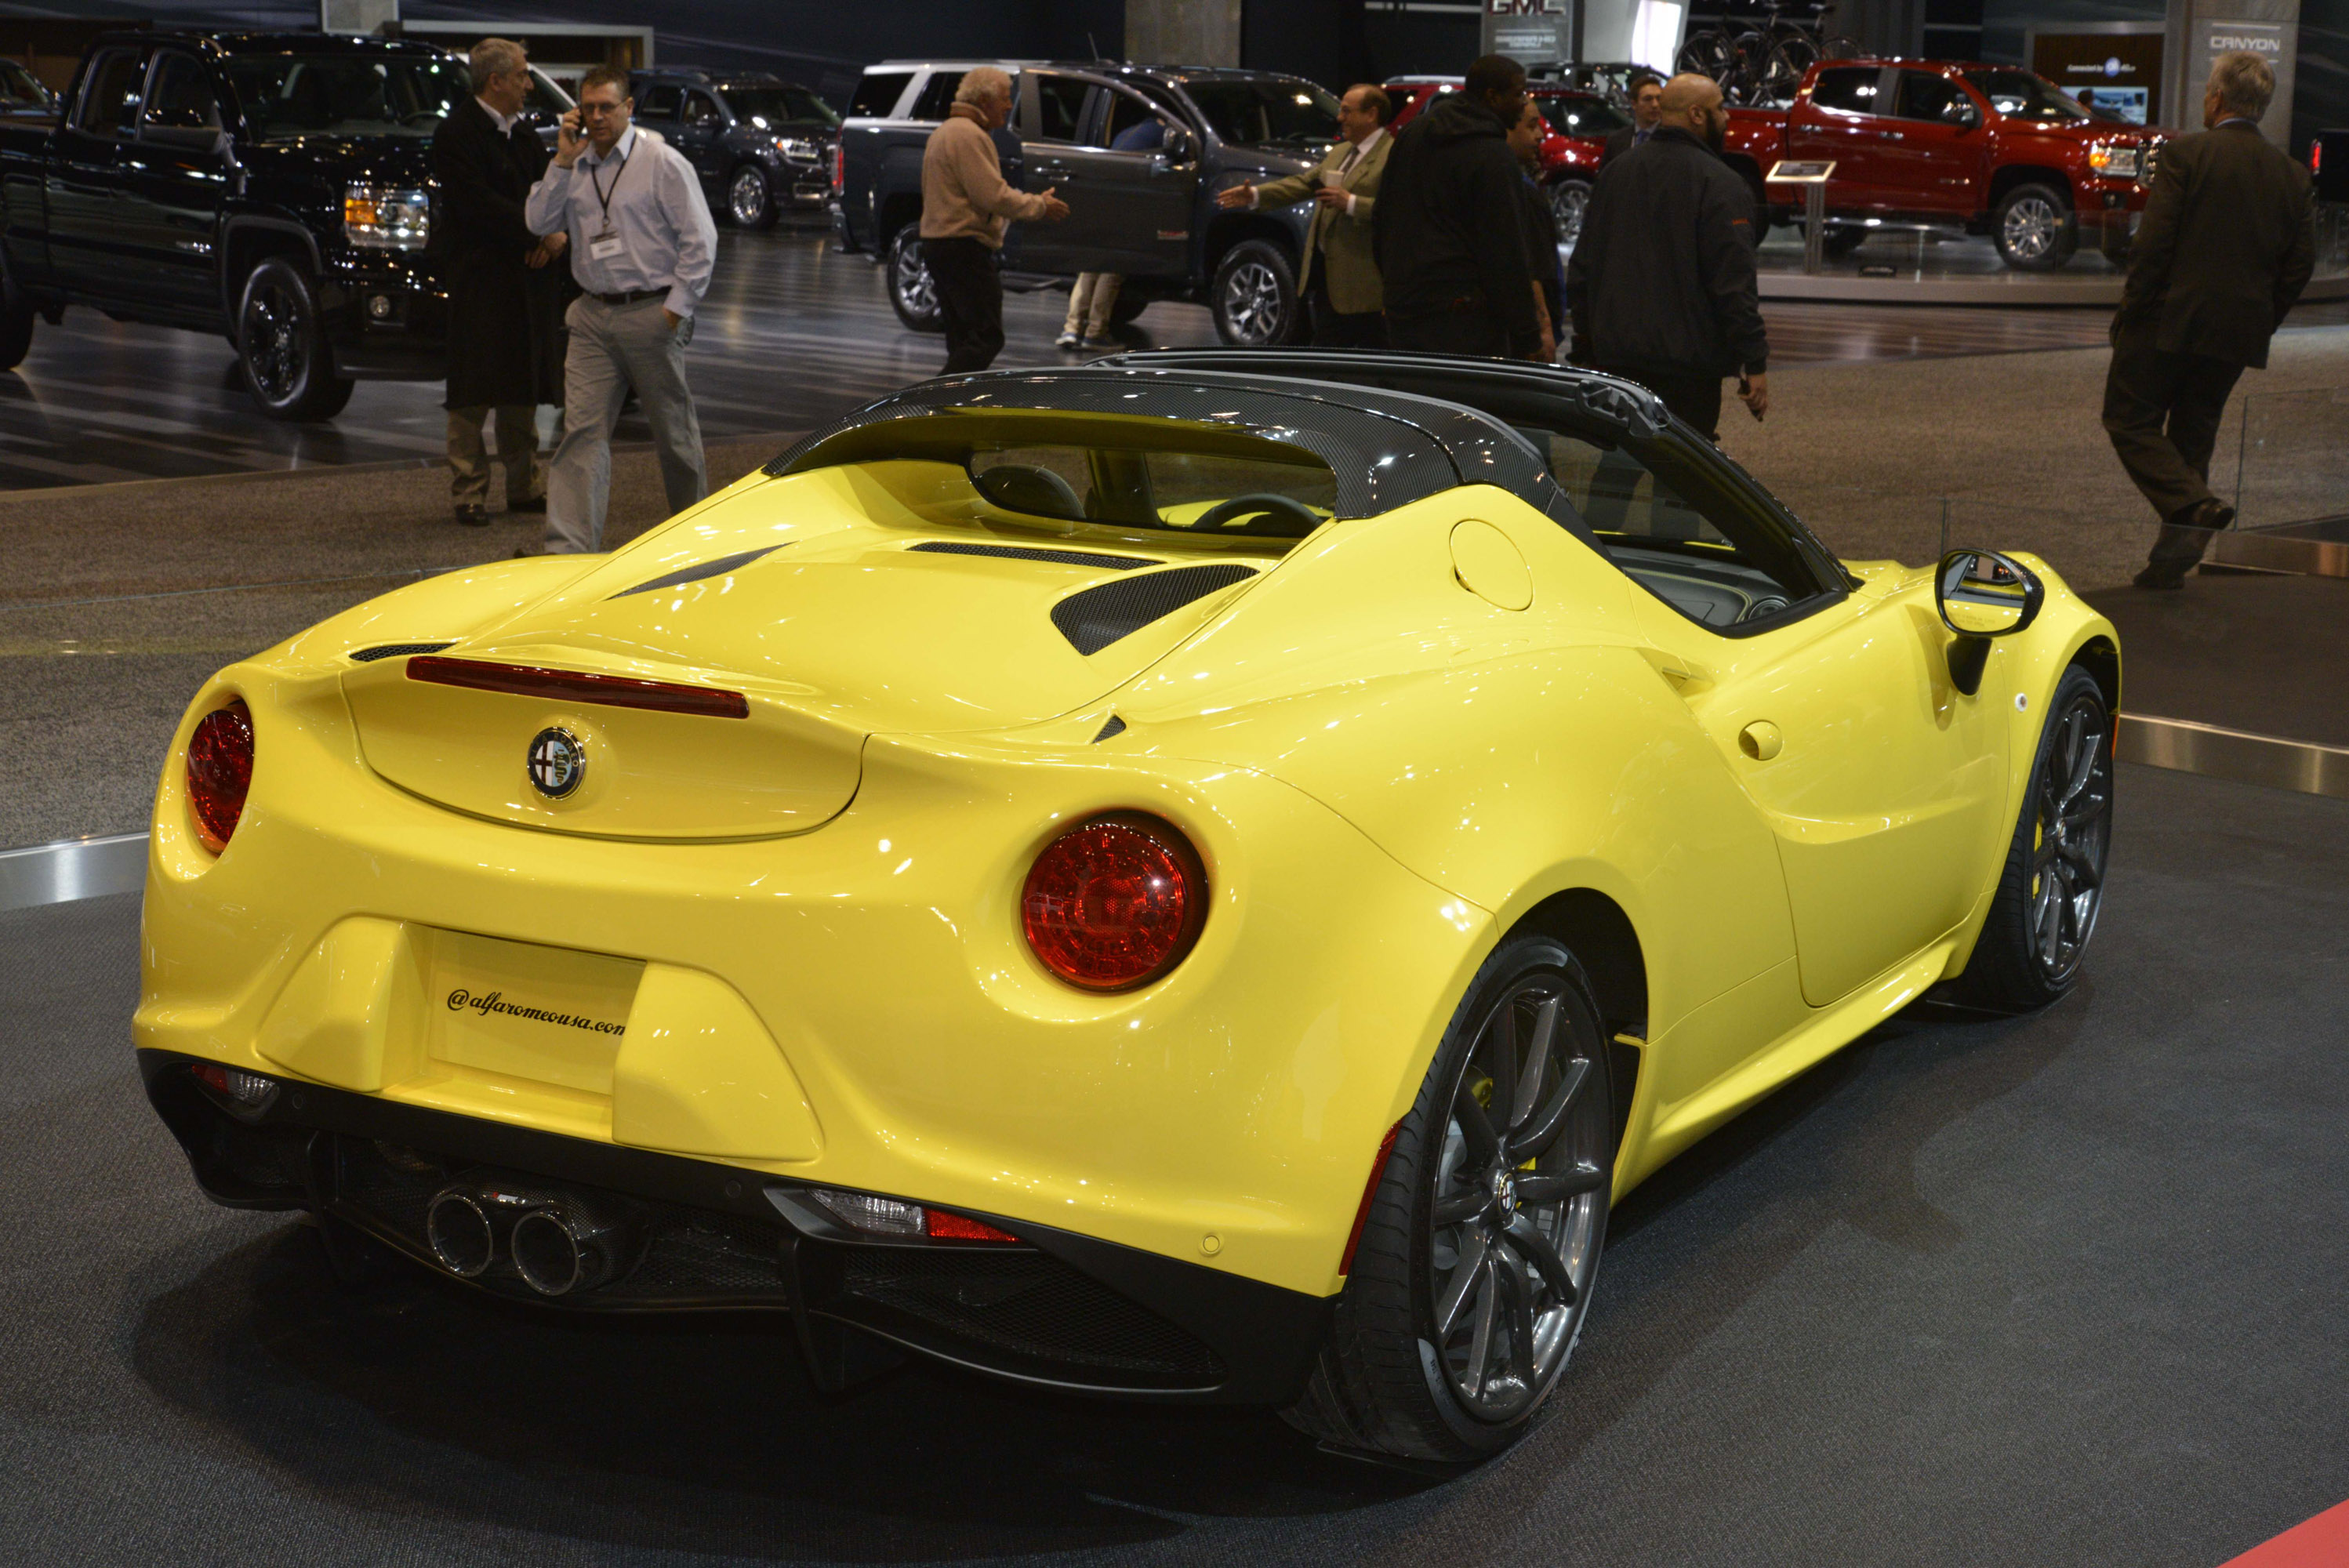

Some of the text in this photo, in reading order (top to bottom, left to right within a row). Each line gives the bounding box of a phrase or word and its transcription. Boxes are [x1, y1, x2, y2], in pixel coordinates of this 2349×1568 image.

[1487, 0, 1567, 16] GMC
[2209, 35, 2280, 51] CANYON
[554, 732, 579, 768] ROMEO
